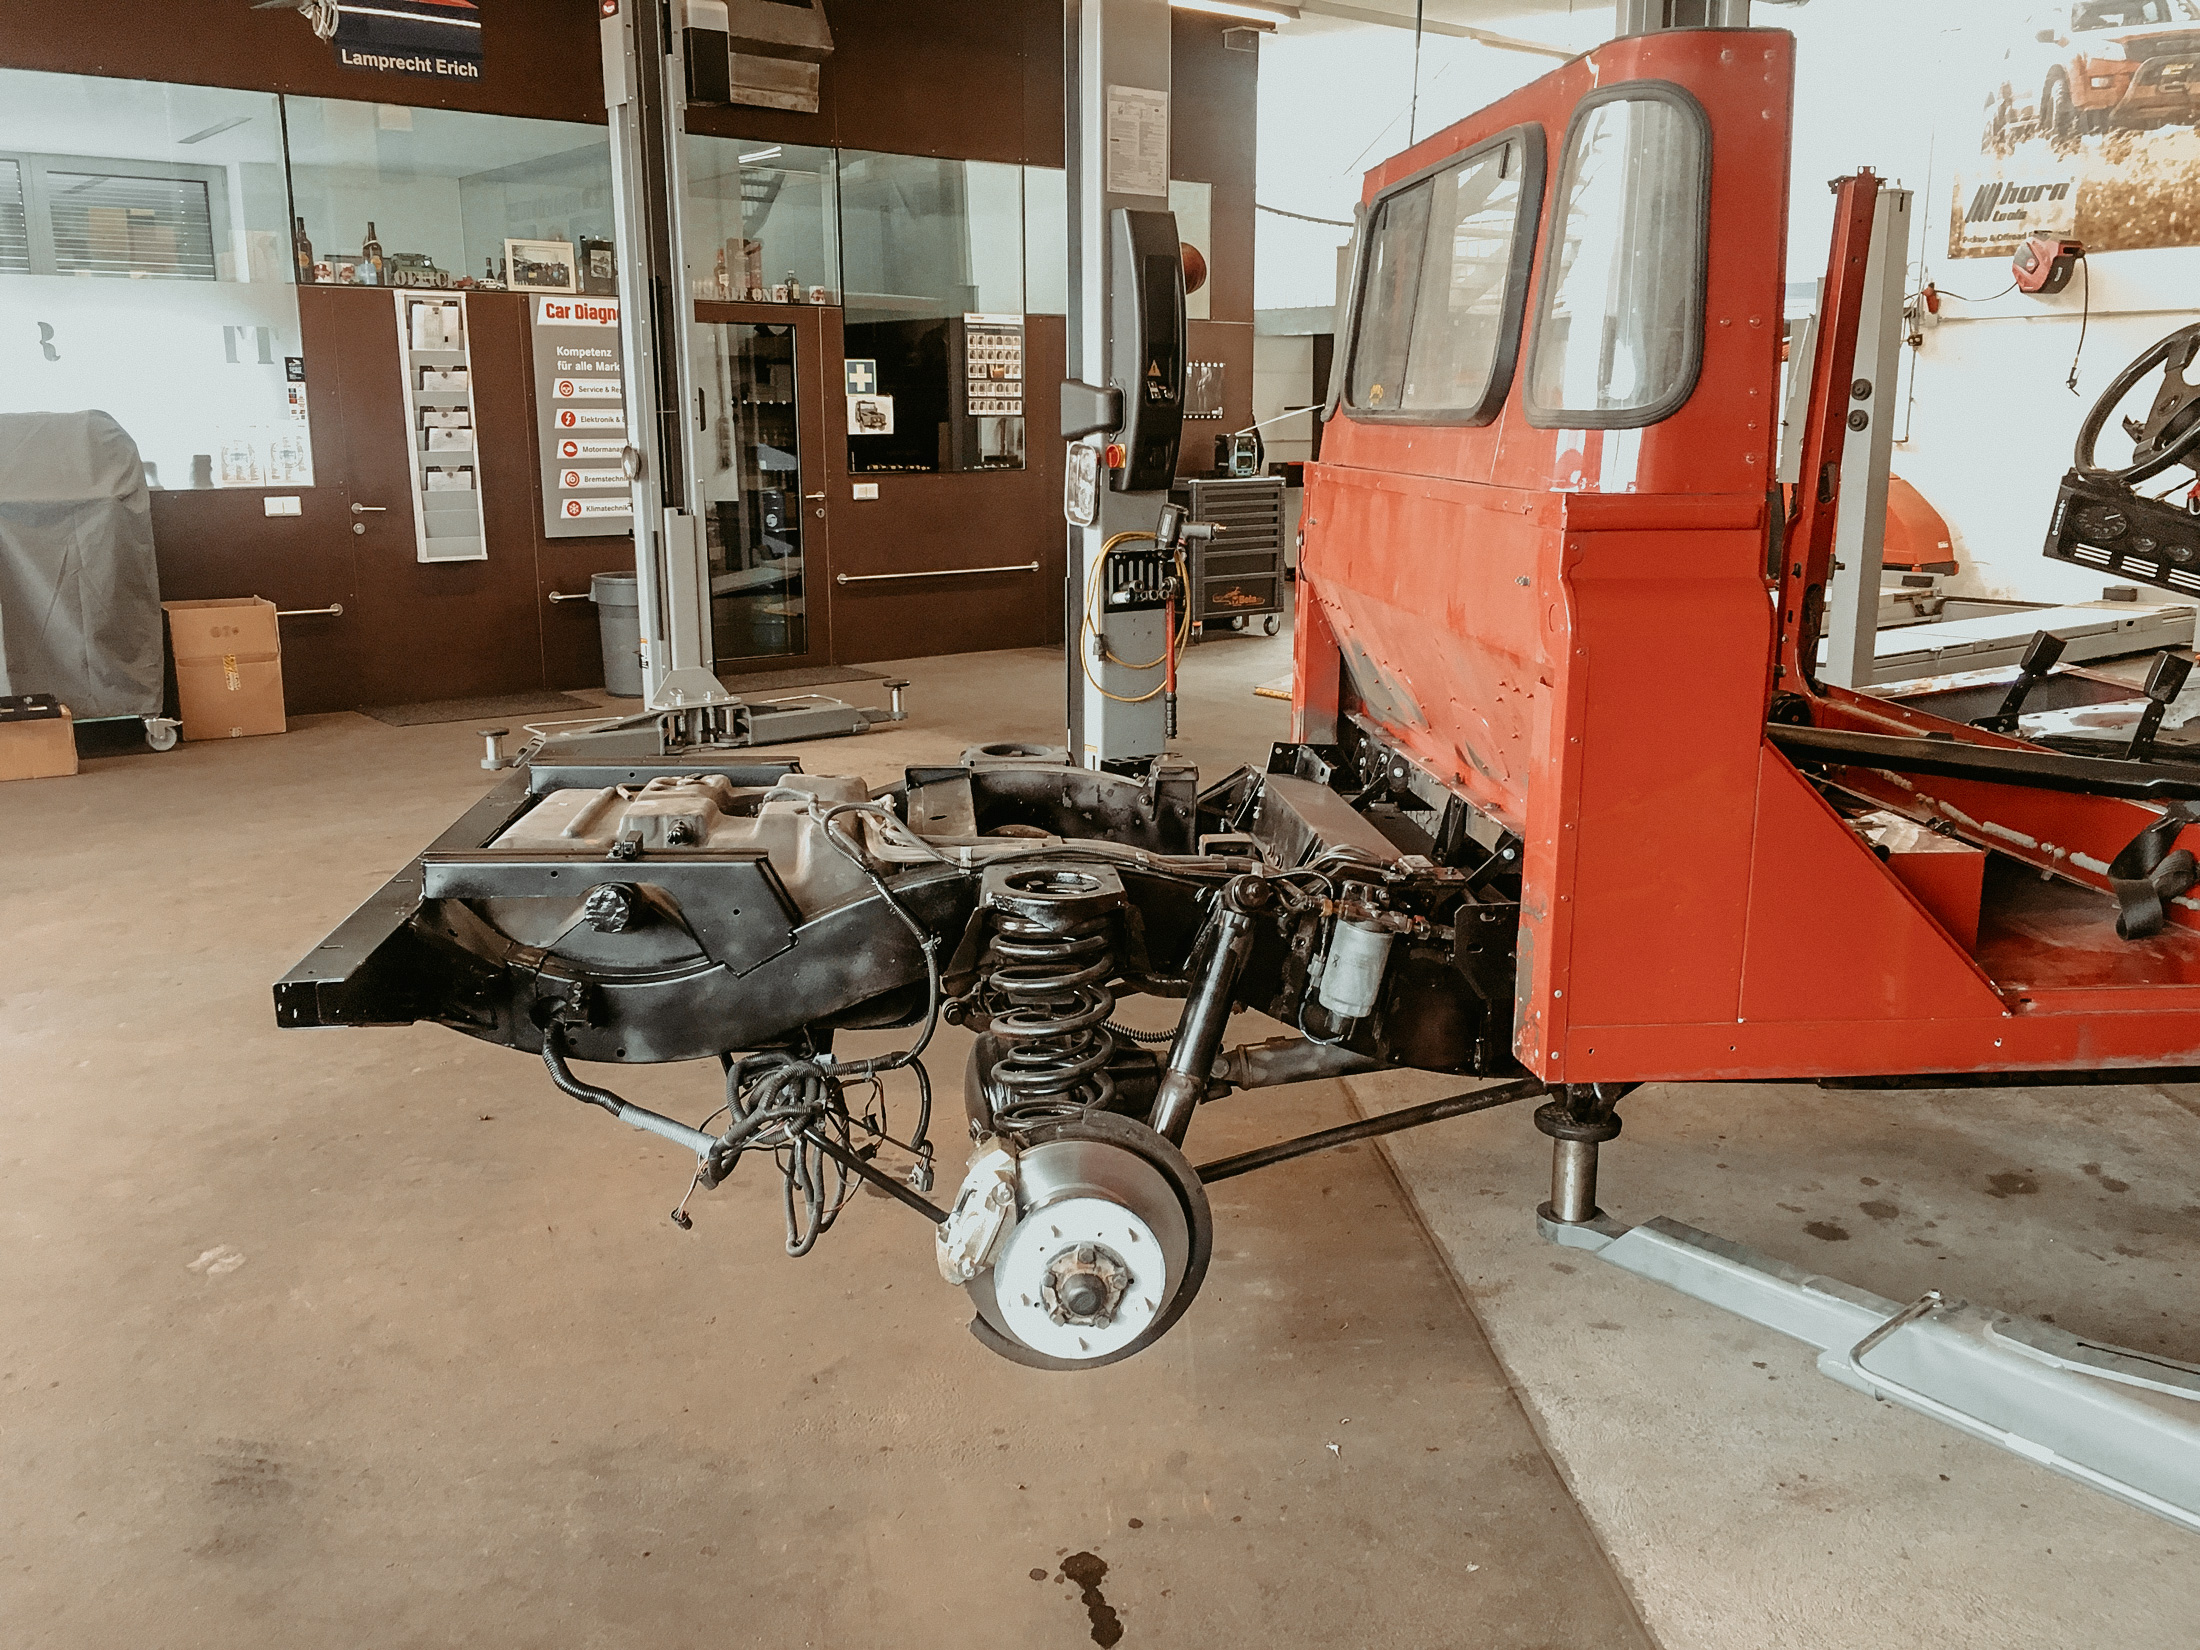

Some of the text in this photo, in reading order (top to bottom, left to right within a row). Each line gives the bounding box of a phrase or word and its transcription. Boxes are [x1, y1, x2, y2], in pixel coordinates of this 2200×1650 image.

[341, 48, 479, 78] Lamprecht Erich
[1999, 181, 2070, 205] horn
[1992, 208, 2028, 222] tools
[546, 303, 619, 324] Car Diagn
[556, 345, 612, 359] Kompetenz
[557, 360, 572, 371] für
[575, 361, 593, 371] alle
[578, 385, 604, 393] Service
[580, 415, 614, 423] Elektronik
[586, 503, 629, 512] Klimatechnik
